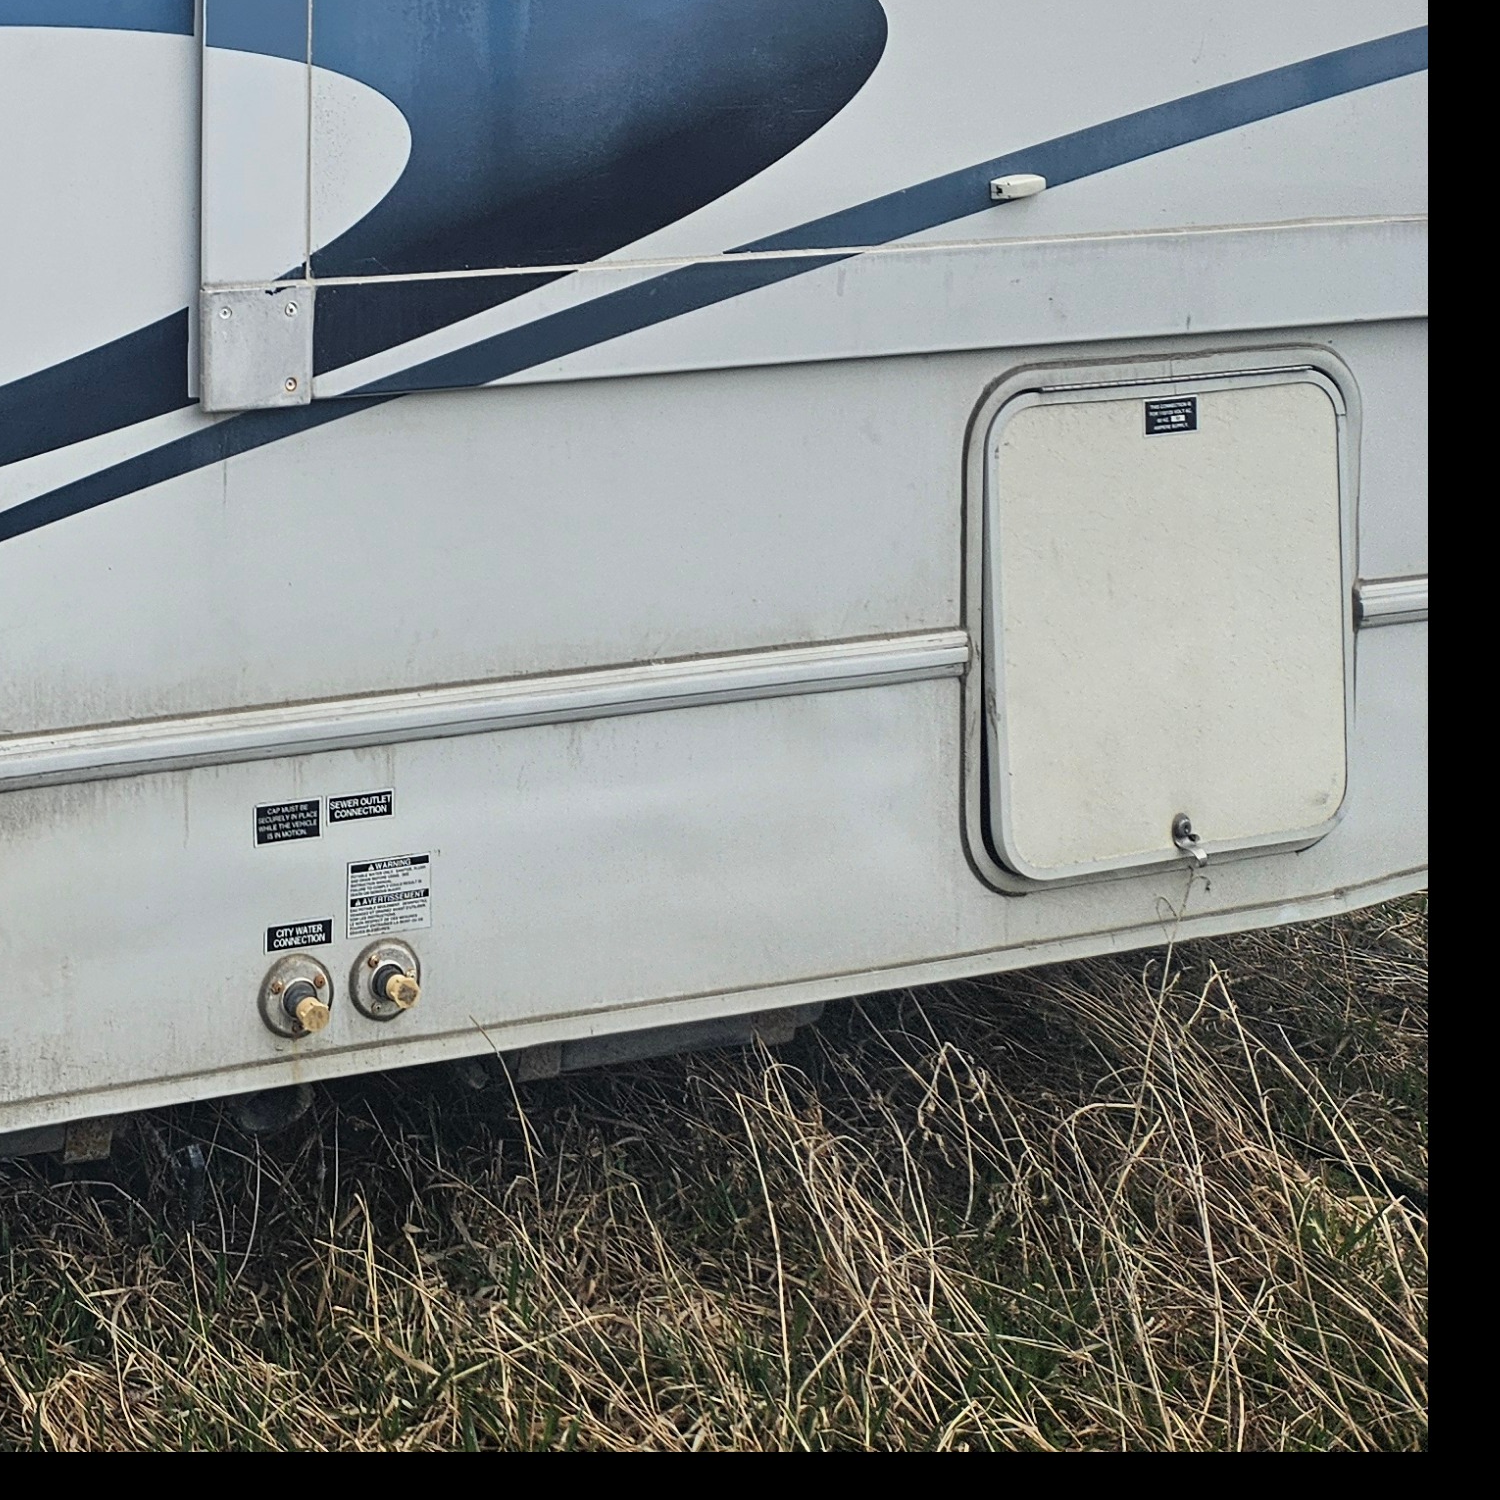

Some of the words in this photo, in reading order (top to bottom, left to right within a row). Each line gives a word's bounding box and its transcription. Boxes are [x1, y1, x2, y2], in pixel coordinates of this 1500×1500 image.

[267, 807, 281, 816] CAP
[281, 804, 299, 814] MUST
[299, 803, 309, 812] BE
[329, 799, 359, 811] SEWER
[360, 794, 392, 806] OUTLET
[258, 814, 290, 826] SECURELY
[290, 812, 298, 821] IN
[299, 810, 318, 820] PLACE
[334, 804, 388, 819] CONNECTION
[258, 822, 278, 833] WHILE
[279, 821, 292, 830] THE
[292, 818, 318, 829] VEHICLE
[267, 832, 274, 840] IS
[274, 831, 282, 840] IN
[375, 858, 411, 870] WARNING
[363, 890, 424, 905] AVERTISSEMENT
[275, 927, 294, 938] CITY
[295, 923, 323, 936] WATER
[273, 932, 326, 949] CONNECTION
